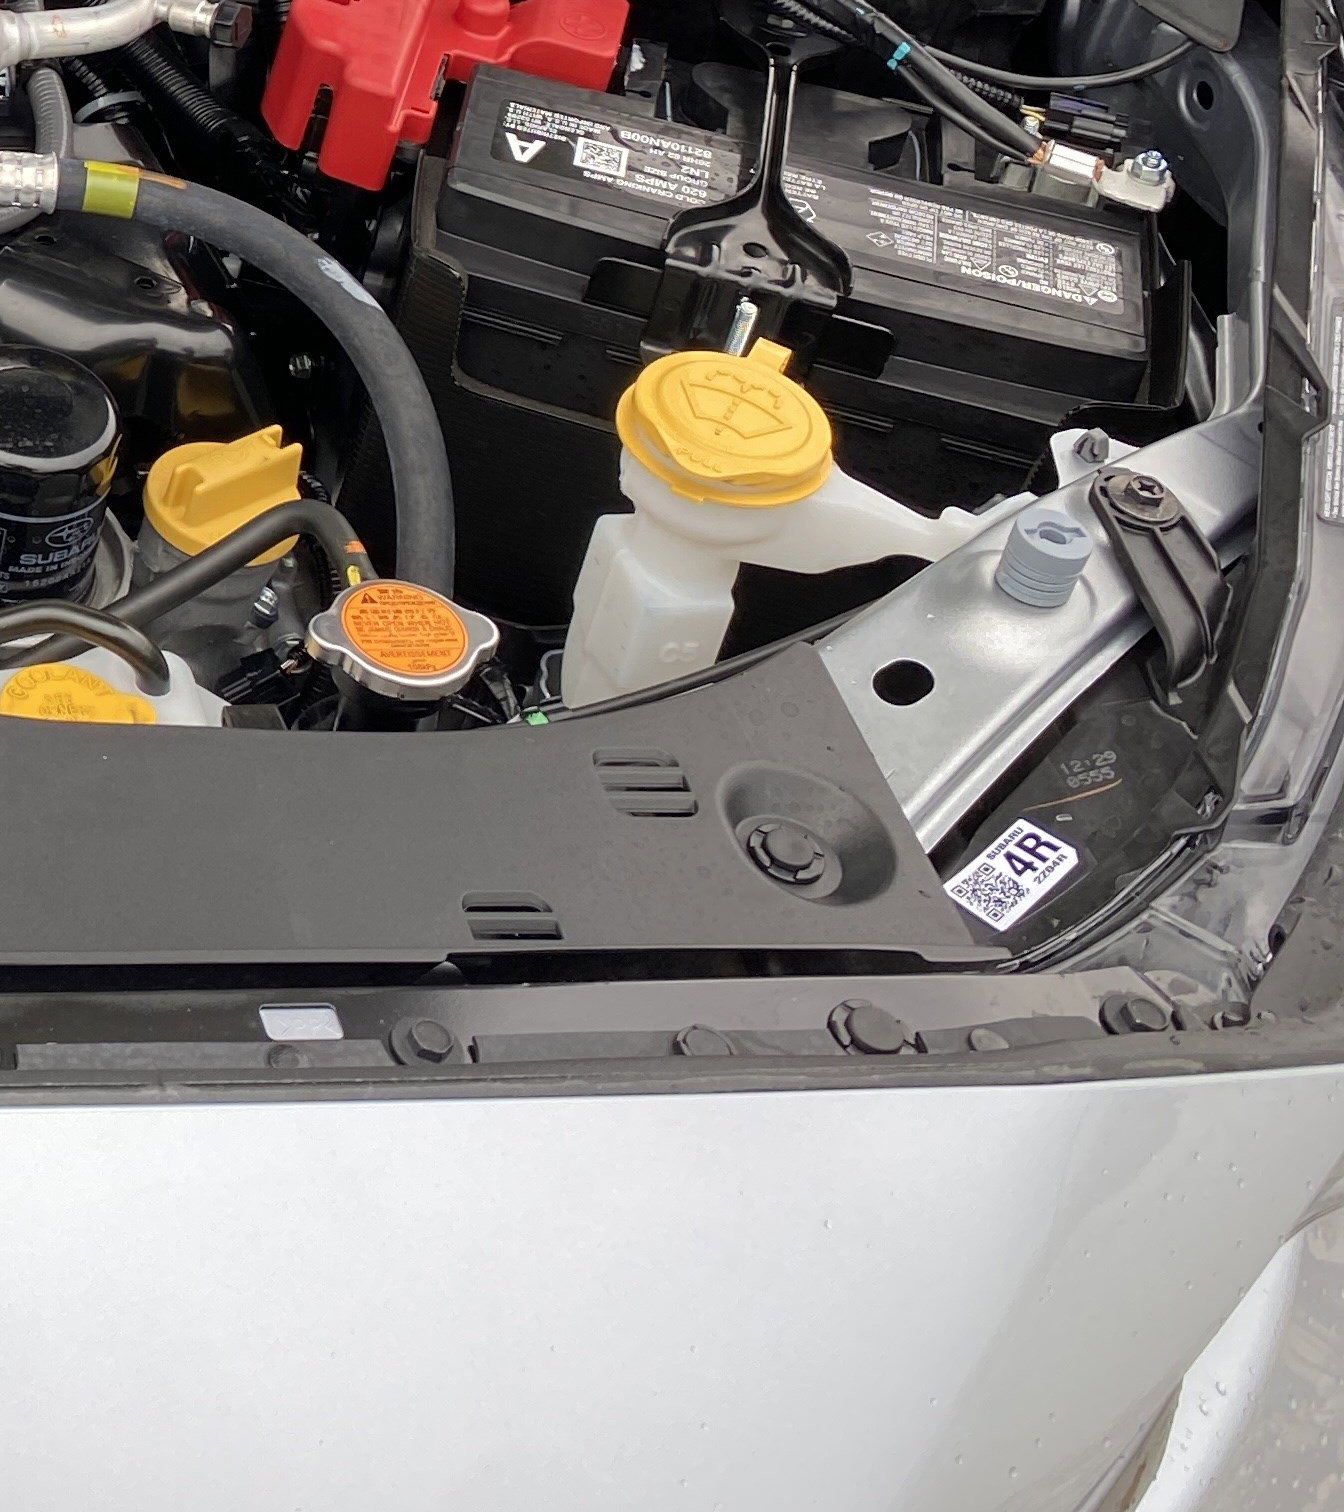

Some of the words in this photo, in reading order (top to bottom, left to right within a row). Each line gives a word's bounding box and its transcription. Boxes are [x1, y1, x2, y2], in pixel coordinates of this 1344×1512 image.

[582, 169, 616, 183] AMPS
[679, 164, 709, 178] LN2
[615, 178, 673, 198] CRANKING
[633, 173, 678, 191] AMPS
[680, 184, 707, 198] 620
[959, 265, 1083, 302] DANGER/POISON
[675, 446, 722, 473] PULL
[8, 565, 43, 574] MADE
[46, 563, 59, 572] IN
[6, 668, 115, 701] COOLANT
[985, 826, 1024, 860] SUBARU
[1003, 831, 1061, 878] 4R
